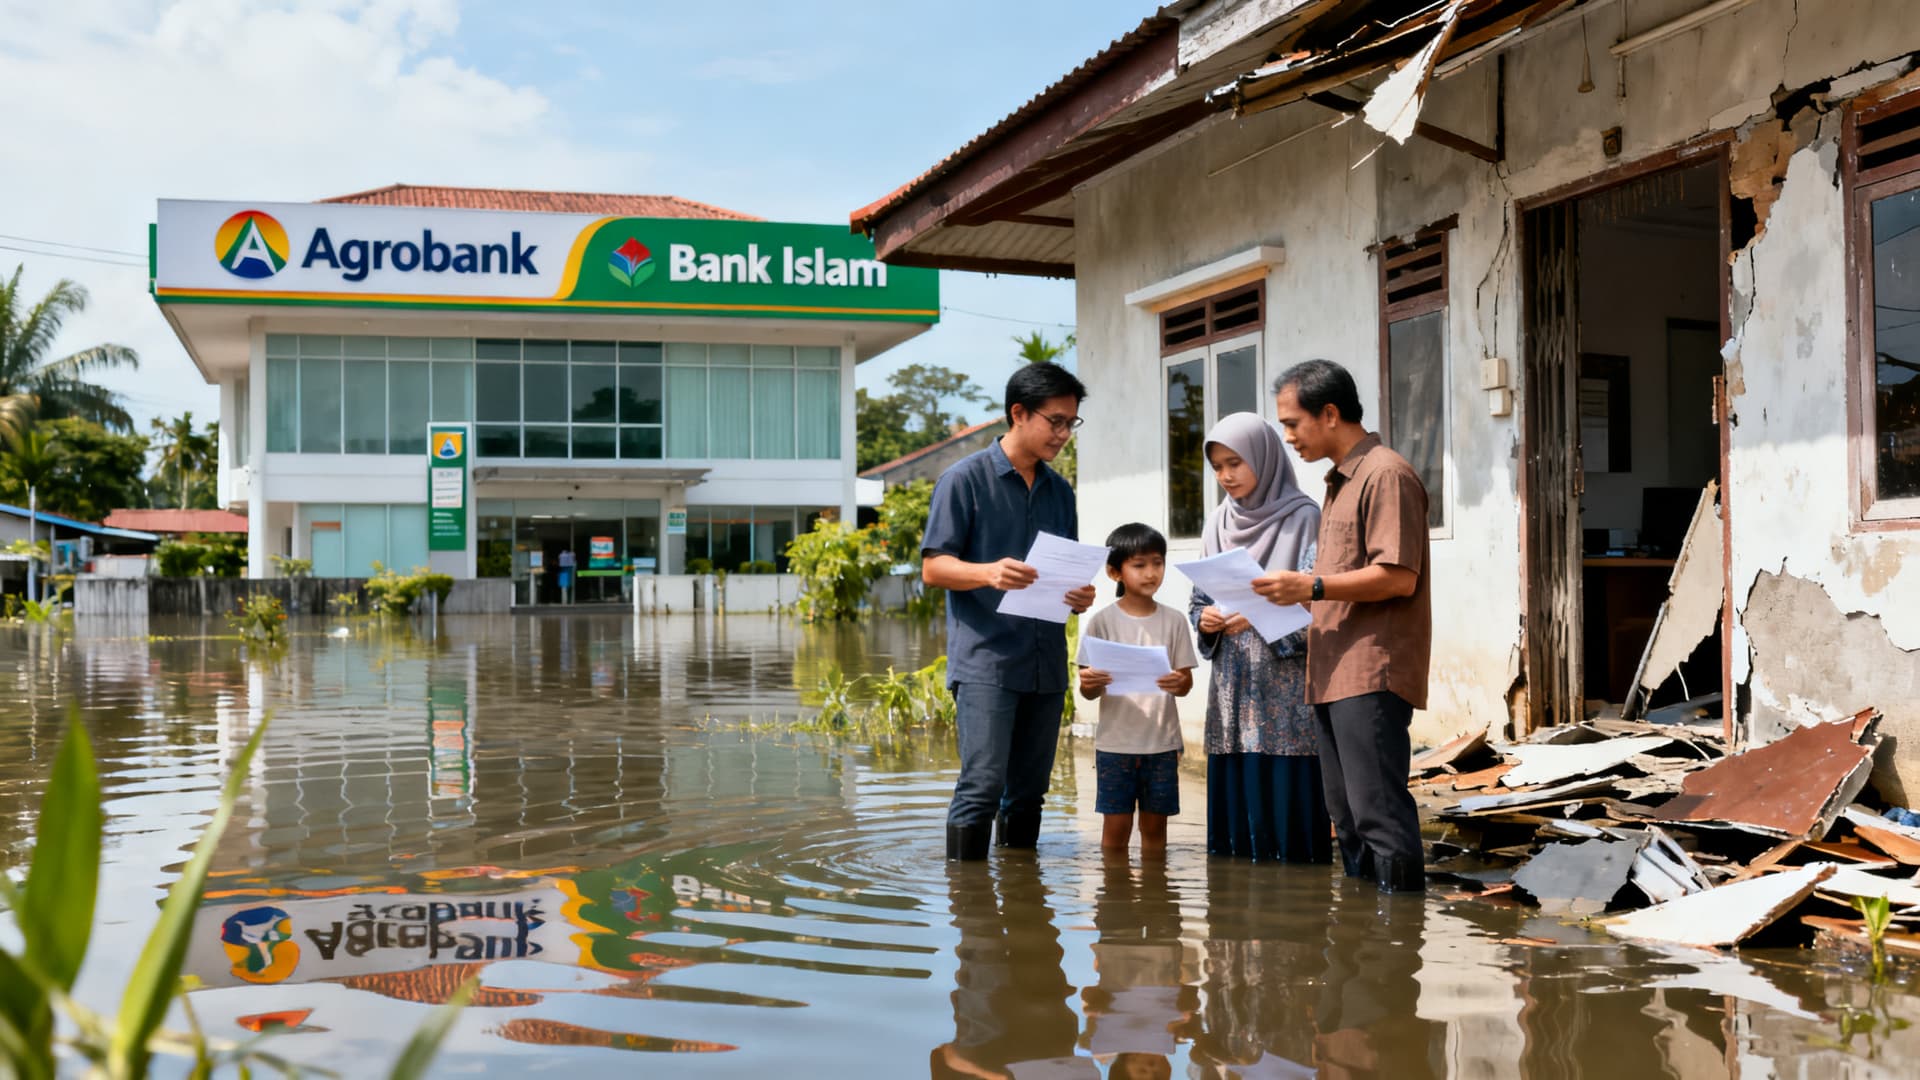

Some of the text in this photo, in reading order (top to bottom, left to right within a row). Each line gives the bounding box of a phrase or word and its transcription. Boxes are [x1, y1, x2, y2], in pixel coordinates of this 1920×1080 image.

[301, 227, 539, 283] Agrobank
[669, 243, 887, 288] Bank Islam
